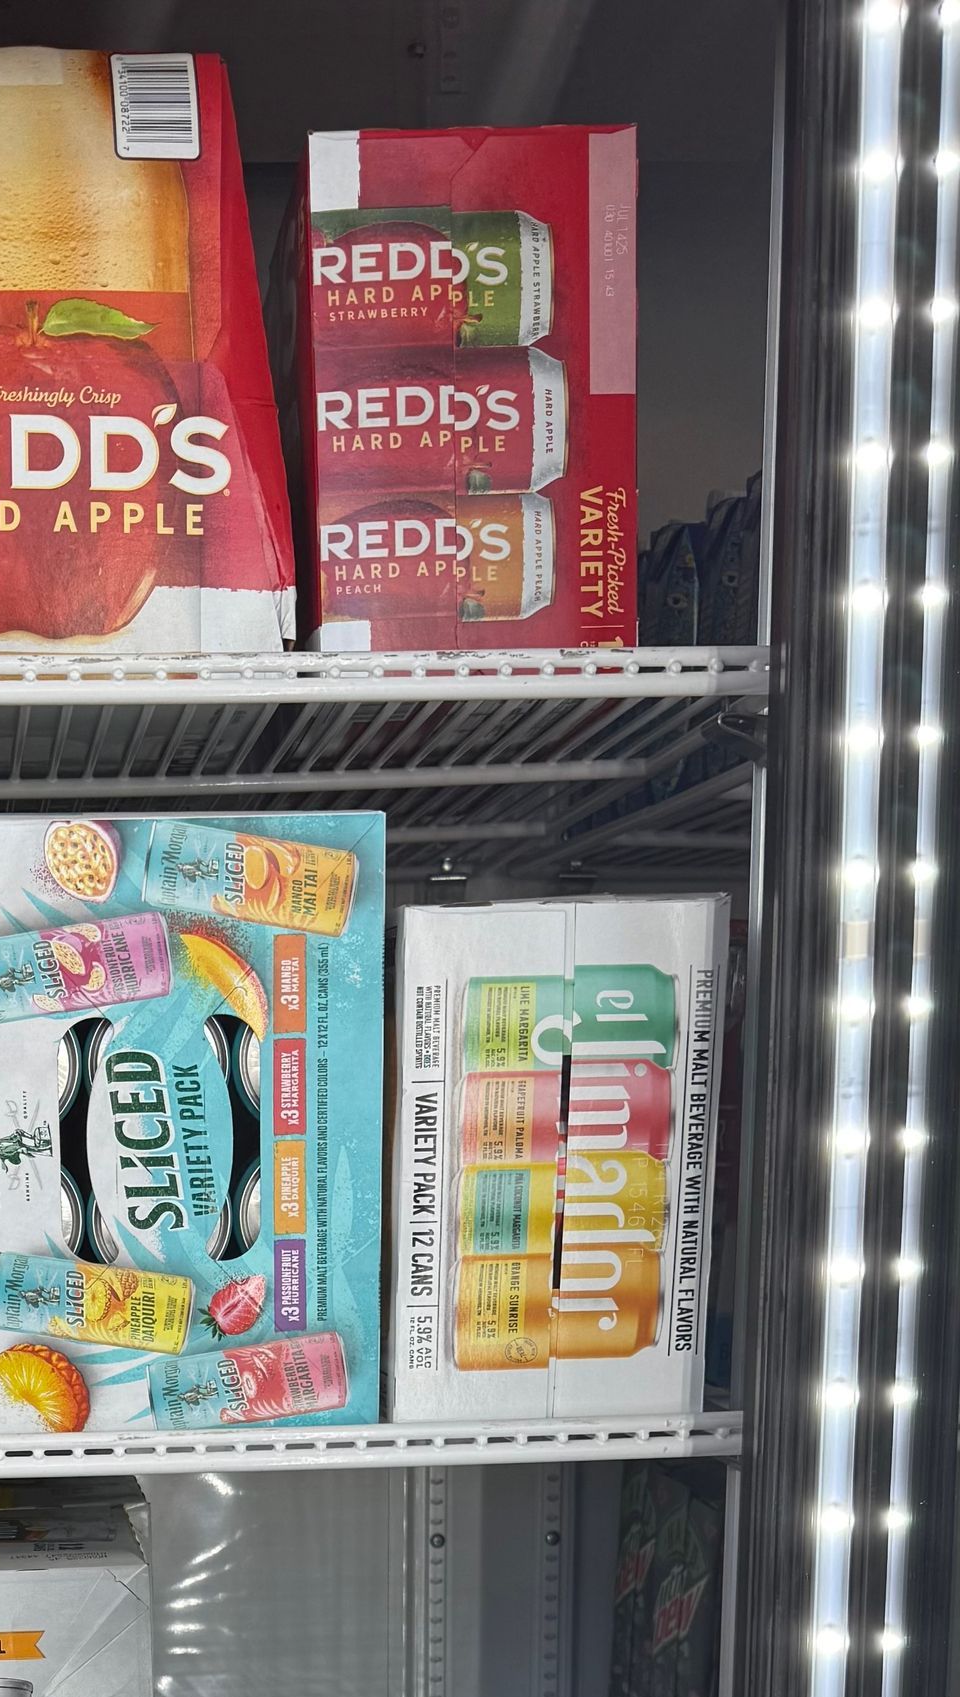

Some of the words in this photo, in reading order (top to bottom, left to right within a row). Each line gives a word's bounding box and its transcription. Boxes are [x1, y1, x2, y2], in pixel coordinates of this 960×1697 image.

[313, 240, 509, 287] REDD'S
[328, 287, 395, 307] HARD
[412, 285, 494, 307] APPLE
[329, 307, 429, 322] STRAWBERRY
[80, 386, 122, 407] Crisp
[318, 385, 520, 431] REDD'S
[53, 501, 204, 536] APPLE
[580, 486, 603, 618] VARIETY
[606, 488, 626, 614] Fresh-Picked
[281, 960, 291, 993] MANGO
[595, 989, 648, 1022] el
[692, 969, 713, 1042] PREMIUM
[691, 1049, 709, 1087] MALT
[172, 1064, 205, 1120] PACK
[106, 1052, 184, 1229] SLICED
[414, 1093, 438, 1166] VARIETY
[686, 1093, 706, 1169] BEVERAGE
[182, 1127, 218, 1216] VARIETY
[413, 1173, 436, 1215] PACK
[683, 1174, 702, 1211] WITH
[412, 1230, 434, 1247] 12
[678, 1215, 700, 1283] NATURAL
[411, 1253, 434, 1296] CANS
[130, 1295, 140, 1341] PINEAPPLE
[142, 1291, 155, 1342] DAIQUIRI
[675, 1290, 695, 1352] FLAVORS
